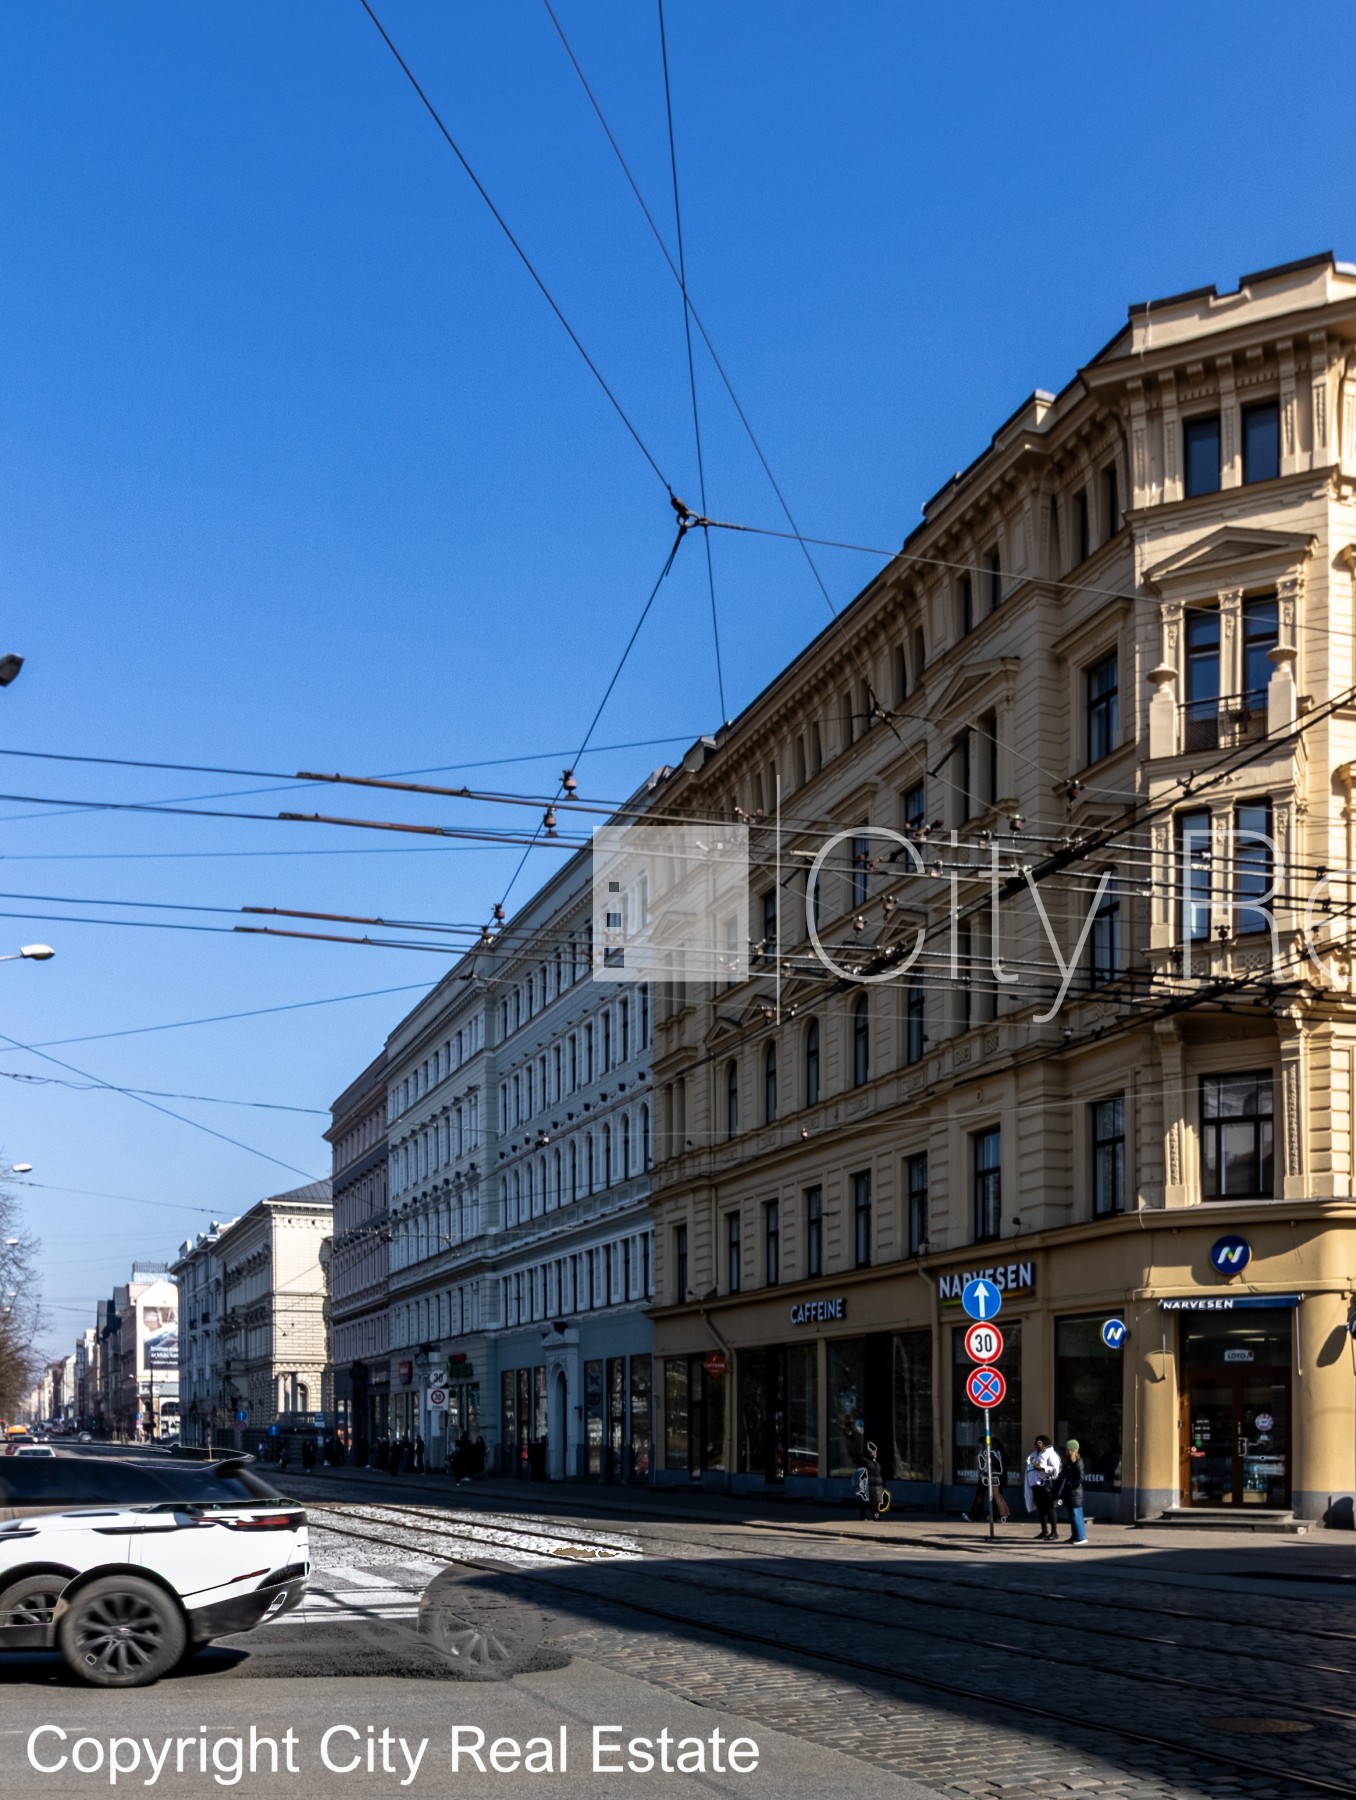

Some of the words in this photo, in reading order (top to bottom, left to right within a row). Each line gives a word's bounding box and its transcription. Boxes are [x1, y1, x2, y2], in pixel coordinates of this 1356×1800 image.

[790, 1298, 843, 1324] CAFFEINE
[1163, 1299, 1234, 1310] NARVESEN
[974, 1333, 993, 1353] 30
[433, 1373, 444, 1383] 30
